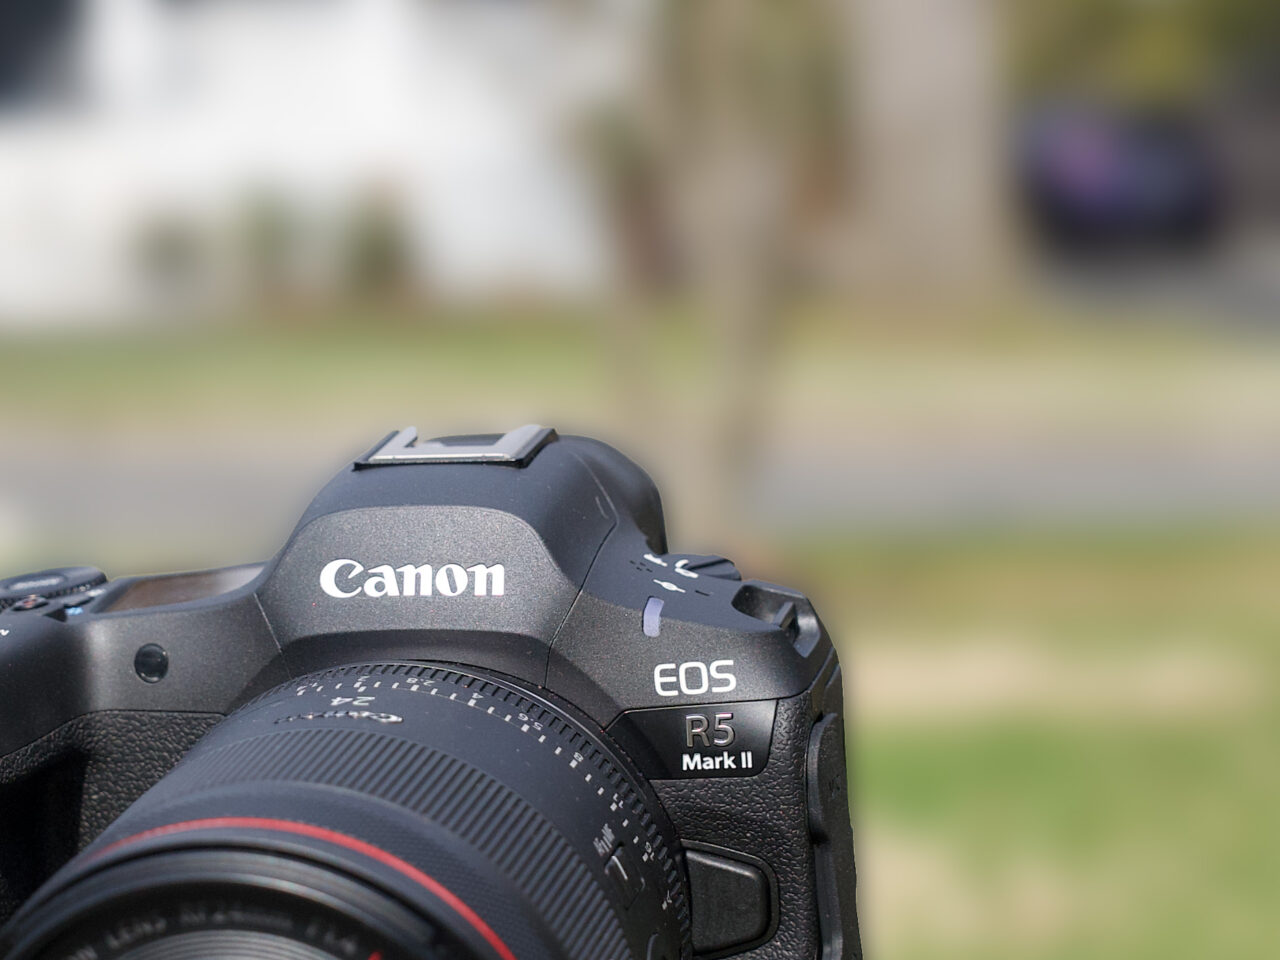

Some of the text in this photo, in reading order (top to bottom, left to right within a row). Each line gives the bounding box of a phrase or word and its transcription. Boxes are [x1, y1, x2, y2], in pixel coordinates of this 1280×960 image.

[320, 559, 505, 598] Canon
[653, 660, 737, 697] EOS
[330, 697, 376, 707] 24
[518, 712, 544, 731] 5.6
[572, 752, 584, 762] 8
[685, 712, 735, 747] R5
[682, 750, 753, 771] Mark II
